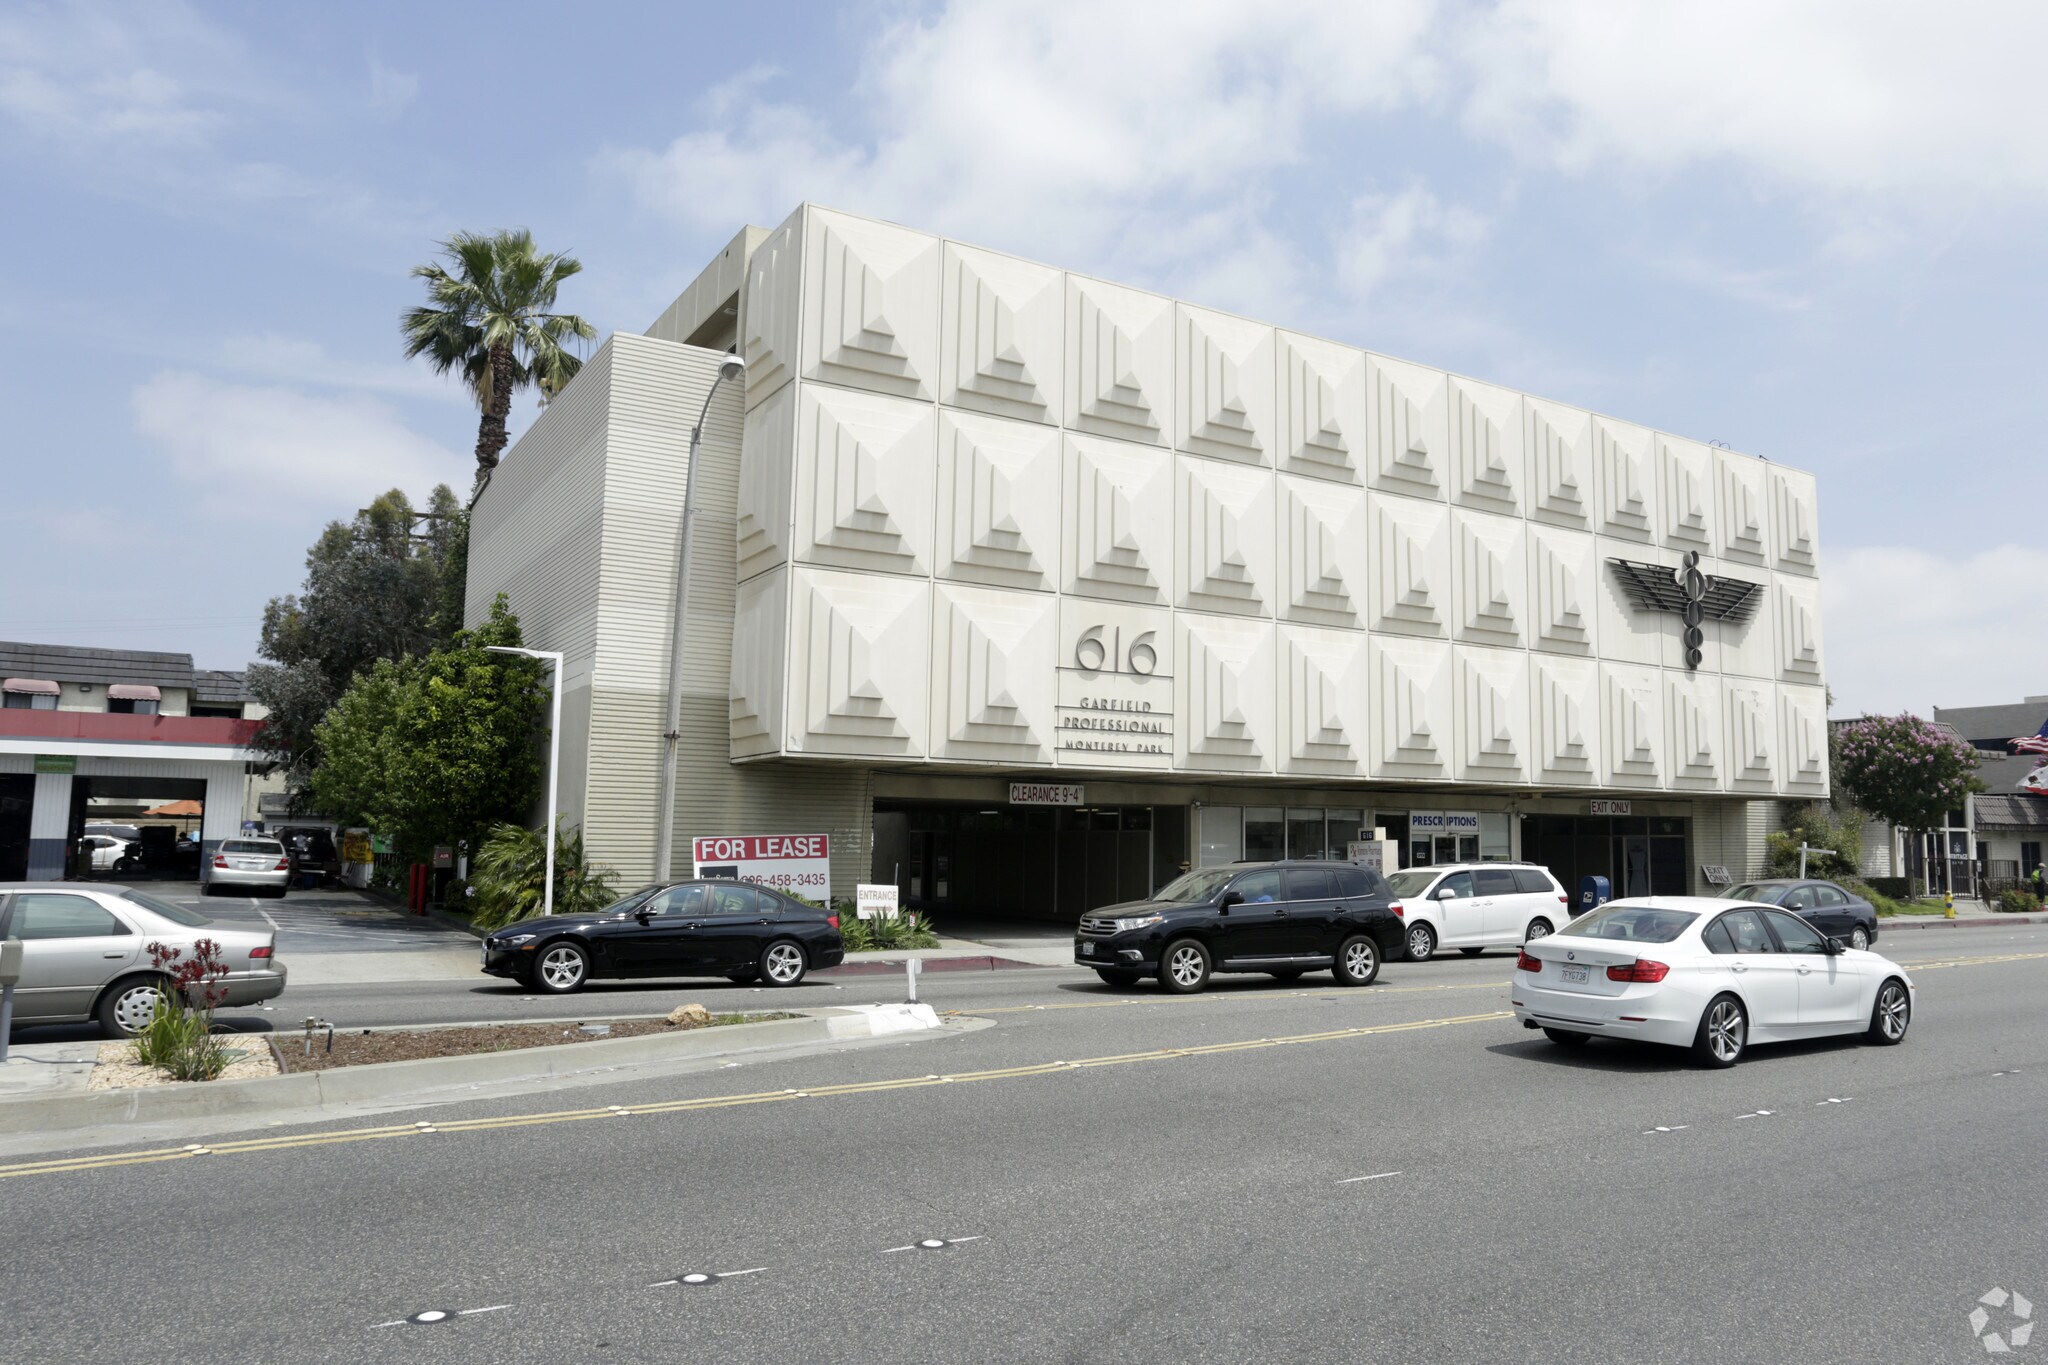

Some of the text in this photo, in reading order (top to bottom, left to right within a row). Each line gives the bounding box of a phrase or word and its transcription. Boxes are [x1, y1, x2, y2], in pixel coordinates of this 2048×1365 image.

[1075, 624, 1157, 675] 616
[1080, 697, 1151, 713] GARFIELD
[1063, 716, 1166, 734] PROFESSIONAL
[1065, 739, 1164, 754] MONTEREY PARK
[1011, 785, 1059, 802] CLEARANCE
[1591, 801, 1630, 814] EXIT ONLY
[701, 839, 746, 860] FOR
[755, 837, 821, 858] LEASE
[1705, 866, 1724, 875] EXIT
[1709, 874, 1731, 883] ONLY
[859, 889, 897, 901] ENTRANCE
